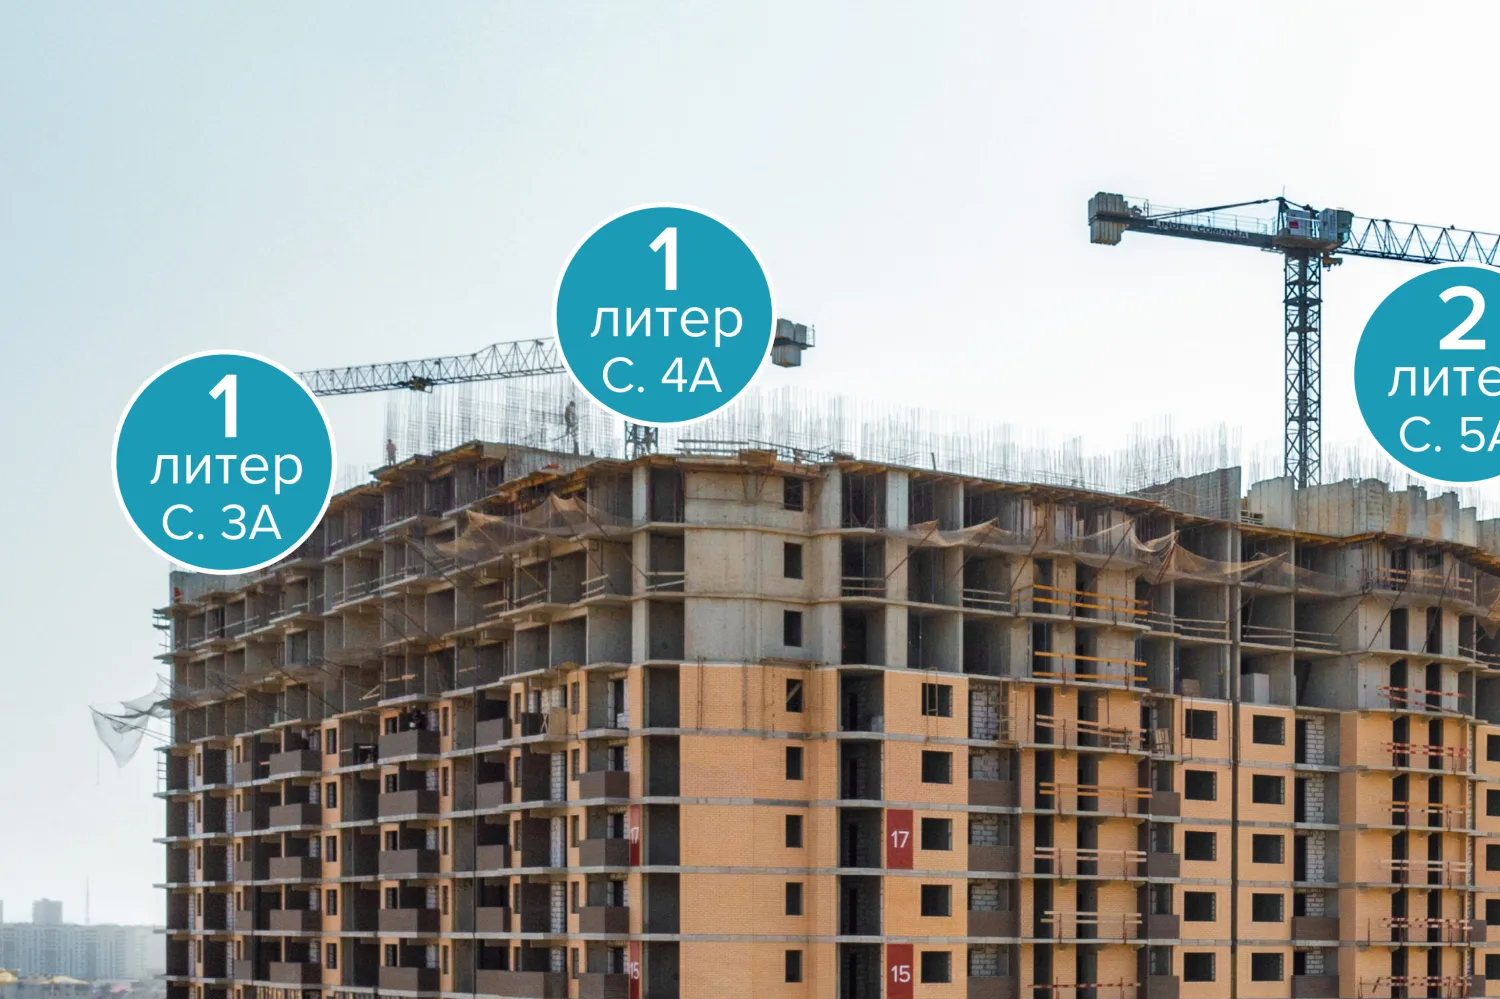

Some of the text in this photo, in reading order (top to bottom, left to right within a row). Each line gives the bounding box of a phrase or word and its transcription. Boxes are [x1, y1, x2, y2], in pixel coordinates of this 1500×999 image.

[890, 830, 910, 848] 17
[629, 961, 640, 980] 15
[890, 964, 911, 983] 15
